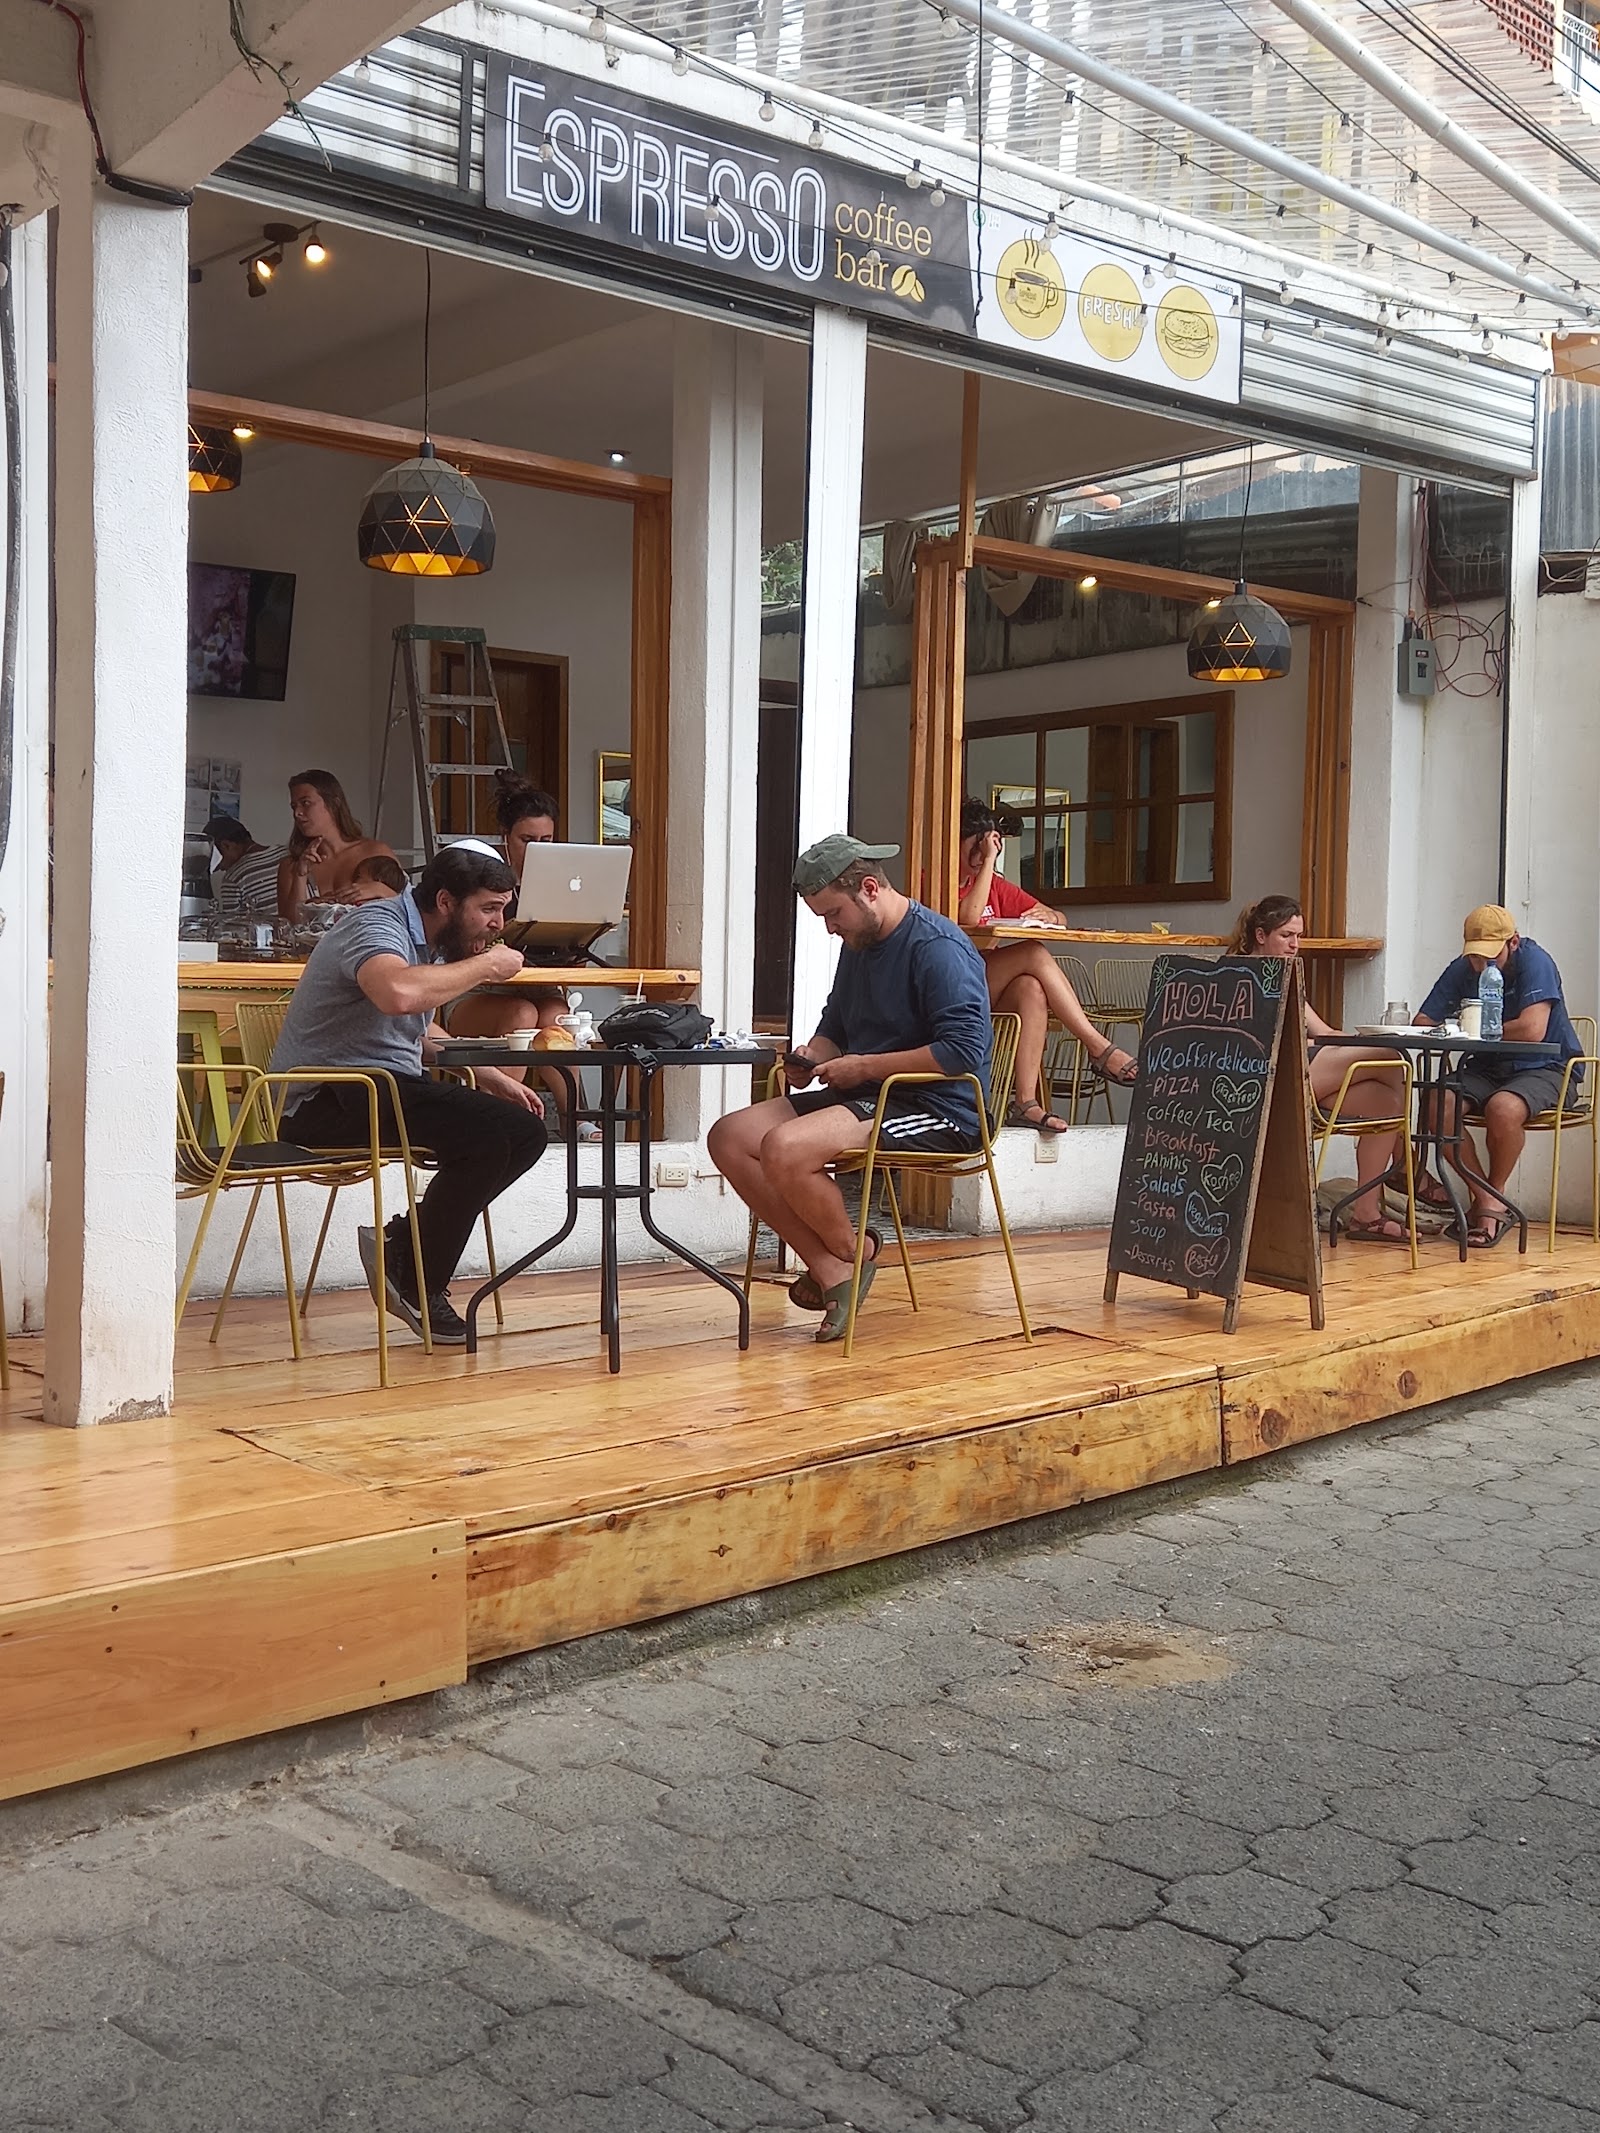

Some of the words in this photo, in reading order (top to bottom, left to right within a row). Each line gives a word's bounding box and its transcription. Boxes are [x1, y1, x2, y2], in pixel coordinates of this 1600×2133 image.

[506, 75, 826, 282] ESPRESSO
[834, 202, 932, 256] coffee
[834, 238, 889, 291] bar
[1162, 979, 1253, 1027] HOLA
[1147, 1043, 1172, 1075] We
[1172, 1041, 1217, 1069] offer
[1205, 1110, 1235, 1133] Tea
